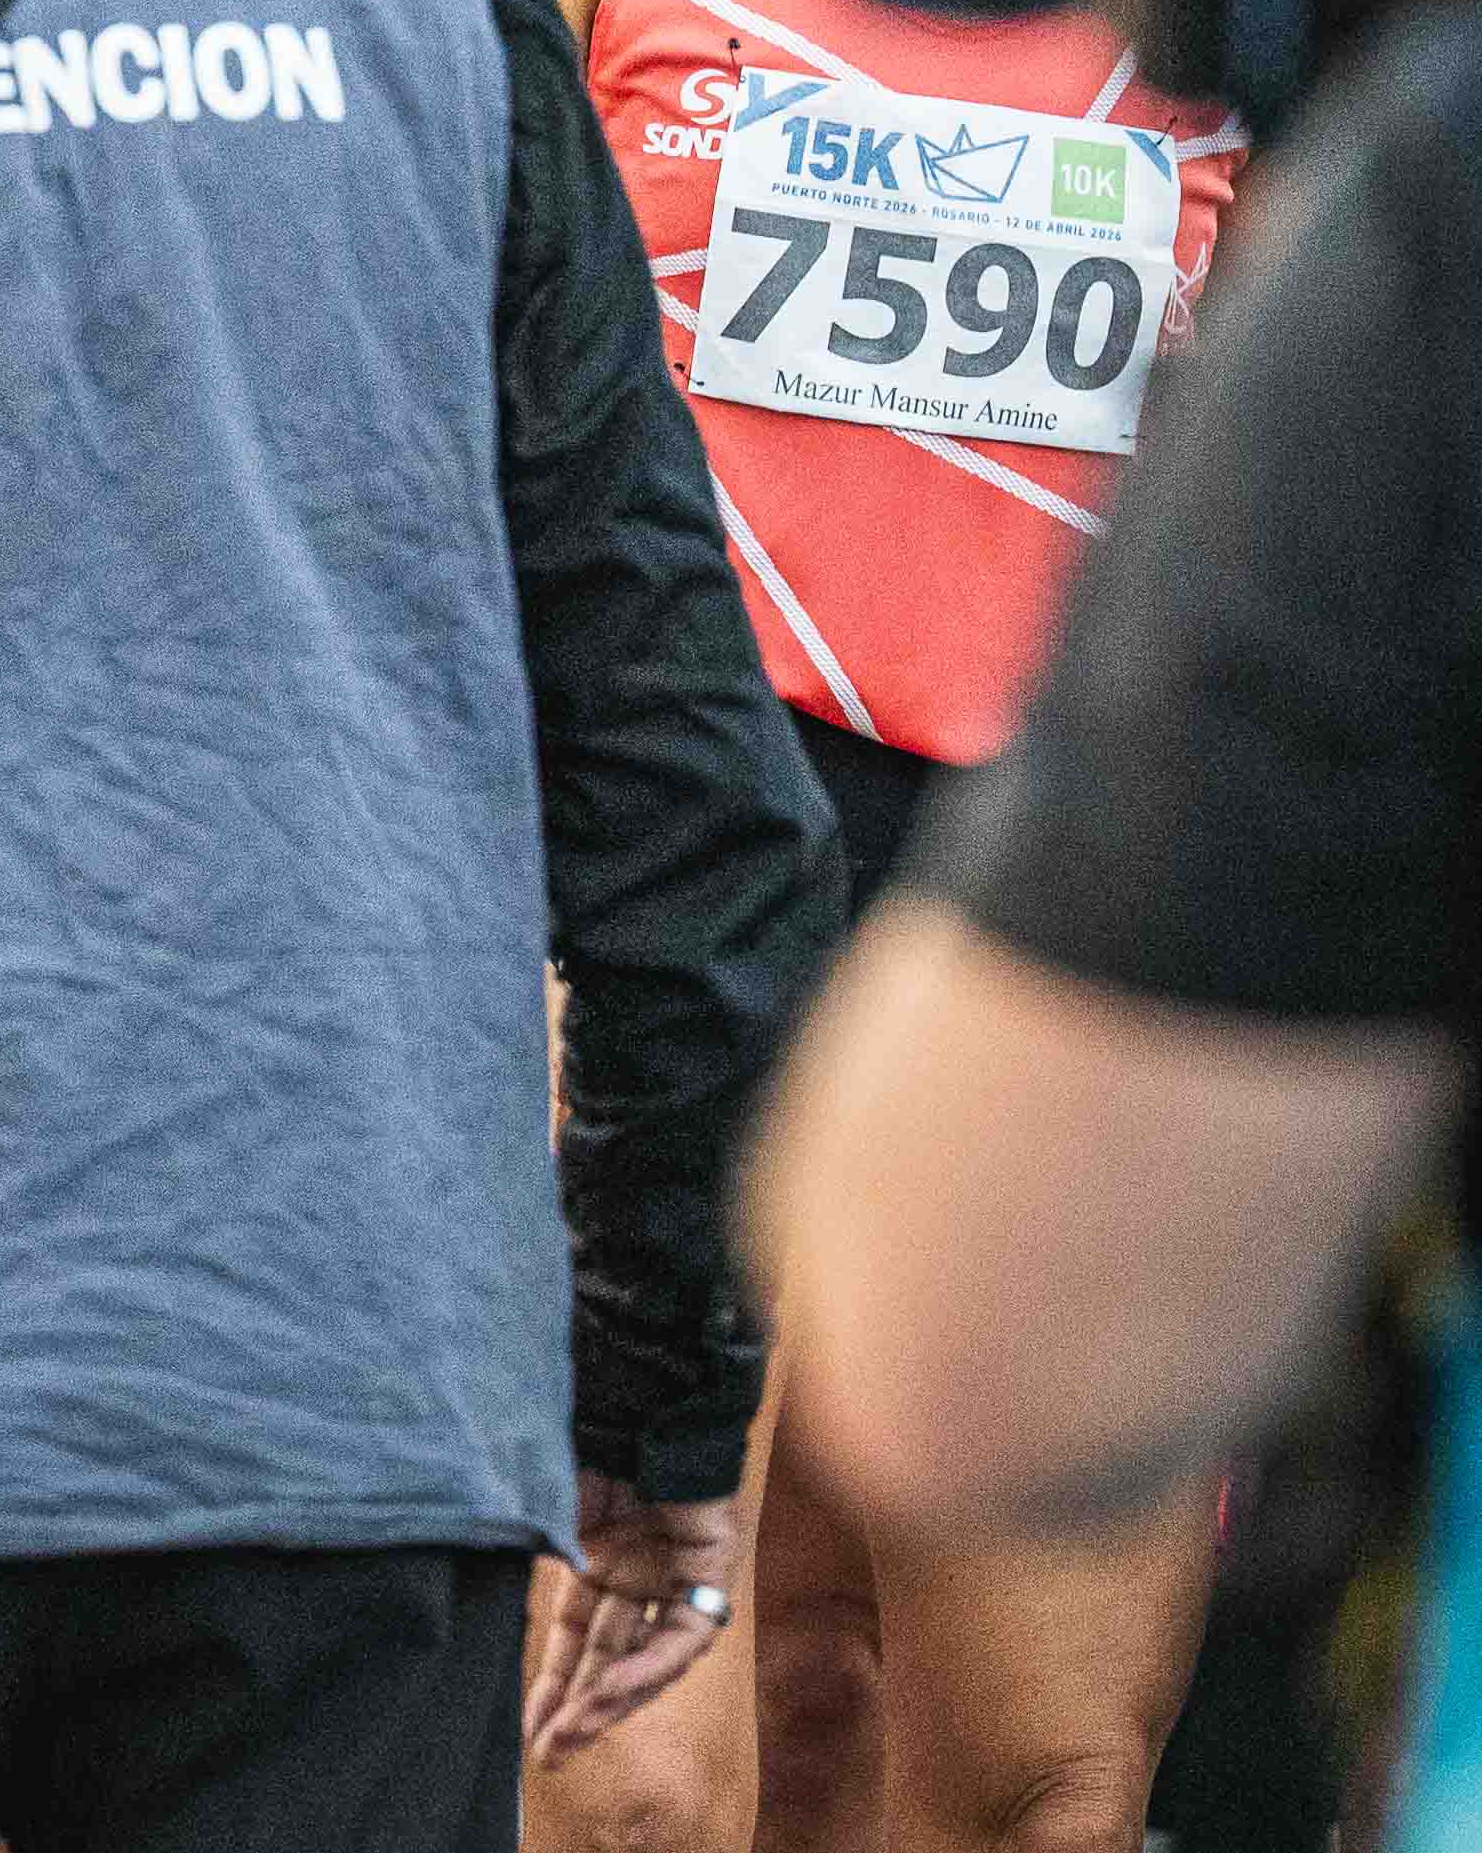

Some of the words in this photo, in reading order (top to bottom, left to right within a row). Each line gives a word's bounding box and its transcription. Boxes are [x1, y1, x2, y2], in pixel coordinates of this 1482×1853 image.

[642, 123, 727, 161] SOND
[780, 115, 903, 191] 15K
[1060, 162, 1118, 199] 10K
[771, 182, 826, 201] PUERTO
[832, 193, 878, 210] NORTE
[884, 200, 916, 215] 2026
[932, 206, 990, 225] ROSARIO
[1006, 217, 1020, 229] 12
[1025, 219, 1042, 231] DE
[1046, 222, 1085, 237] ABRIL
[1090, 228, 1122, 242] 2026
[719, 207, 1144, 390] 7590
[773, 369, 862, 408] Mazur
[870, 388, 971, 423] Mansur
[975, 396, 1059, 432] Amine
